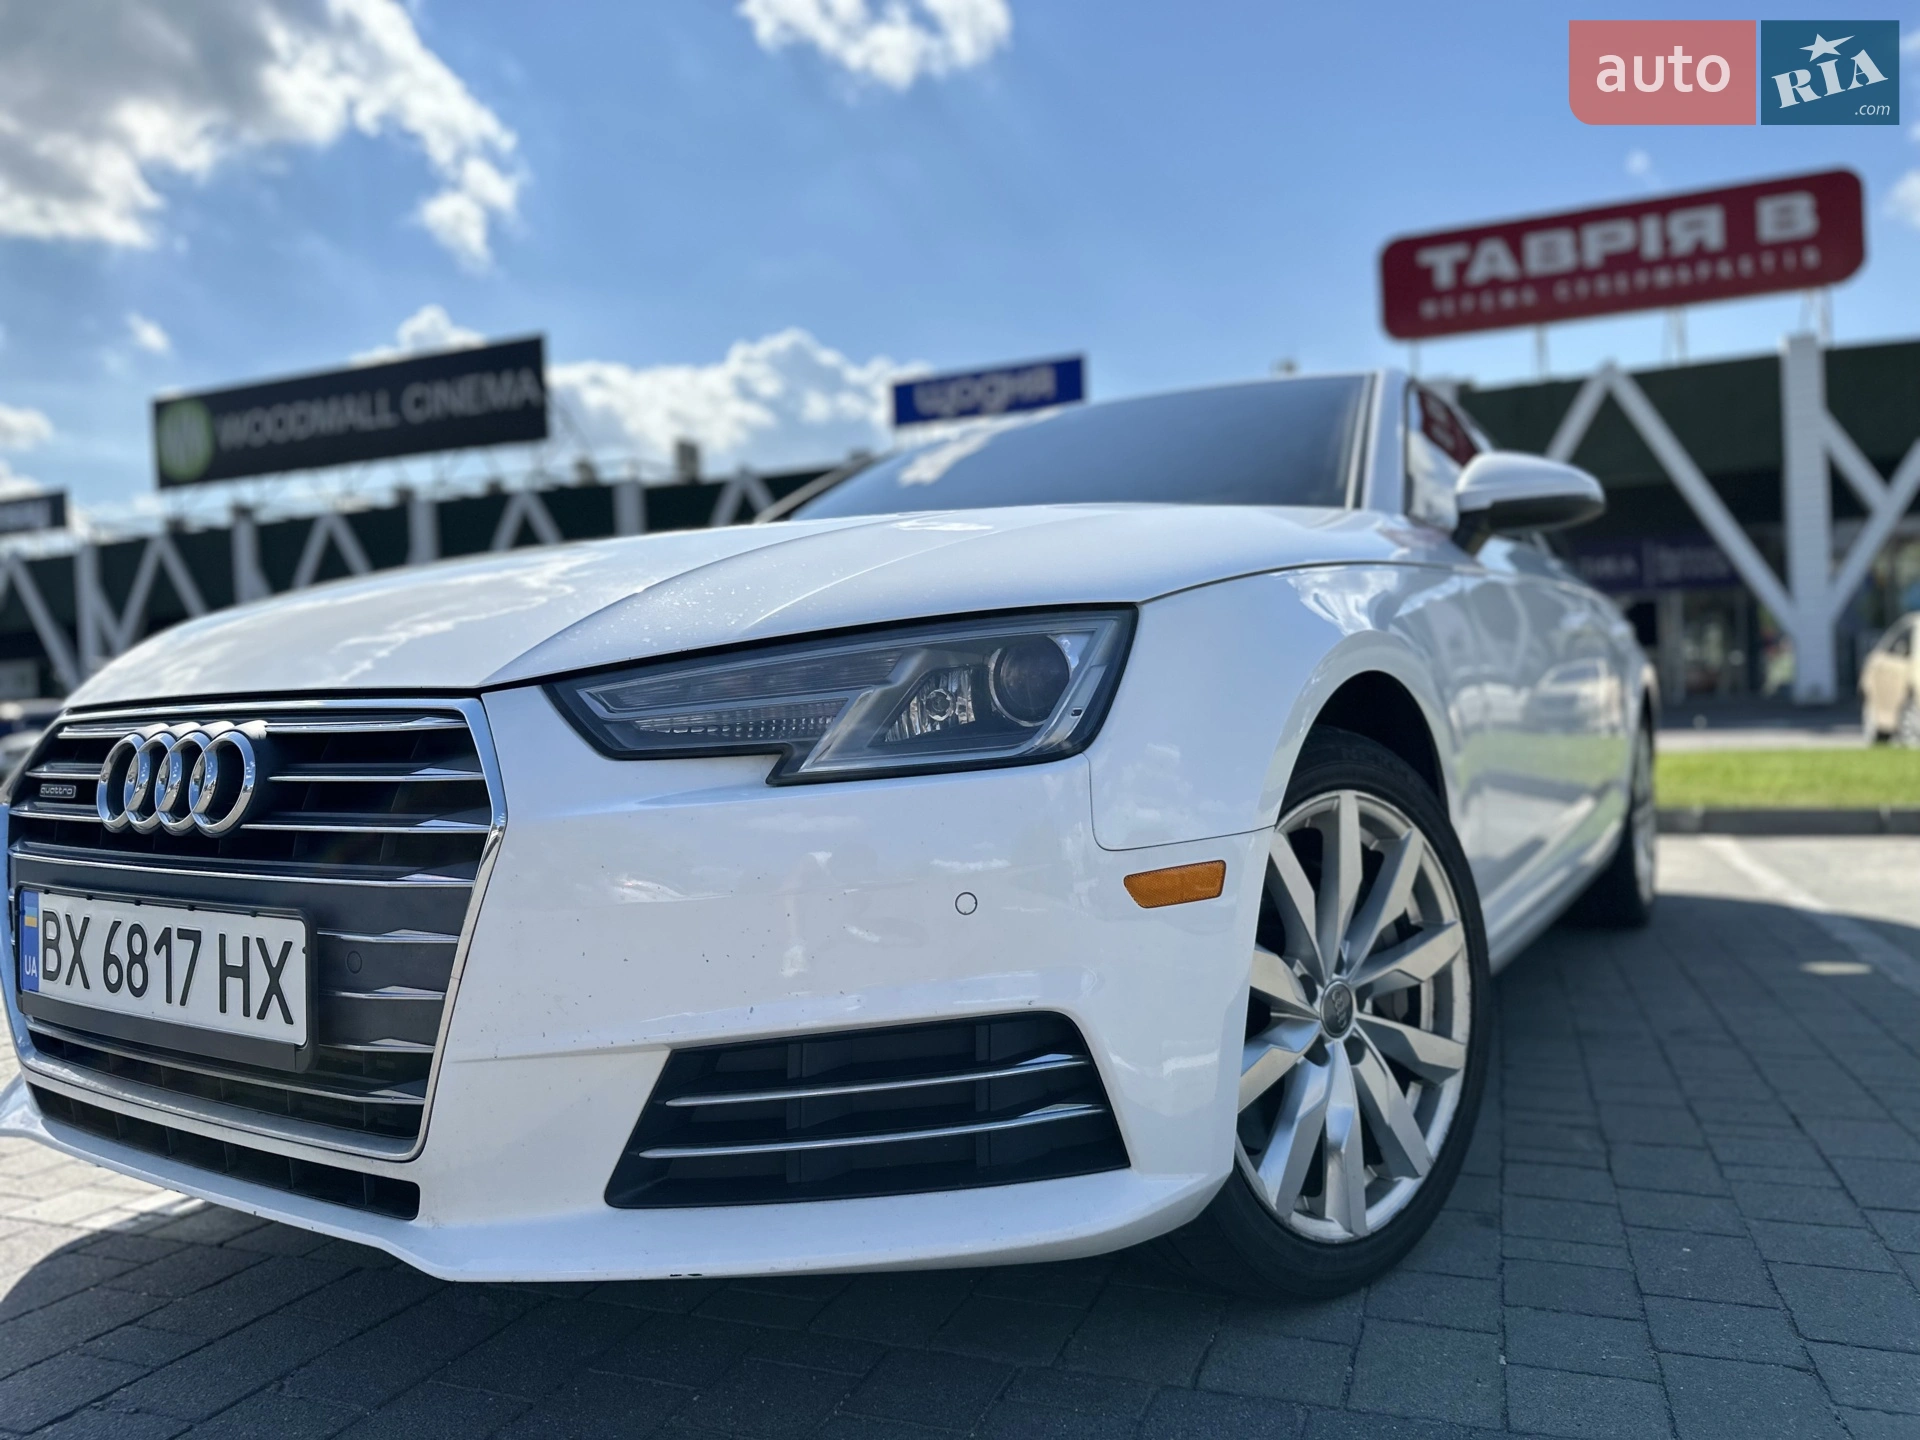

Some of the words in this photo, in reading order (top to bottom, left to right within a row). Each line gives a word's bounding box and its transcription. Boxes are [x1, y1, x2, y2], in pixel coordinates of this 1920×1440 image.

[1415, 203, 1726, 291] ТАВРІЯ
[1755, 191, 1819, 244] В
[217, 388, 398, 452] WOODMALL
[401, 366, 545, 425] CINEMA
[40, 786, 73, 796] quattro
[24, 955, 38, 978] UA
[42, 910, 91, 990] BX
[102, 920, 202, 1006] 6817
[218, 932, 294, 1025] HX
